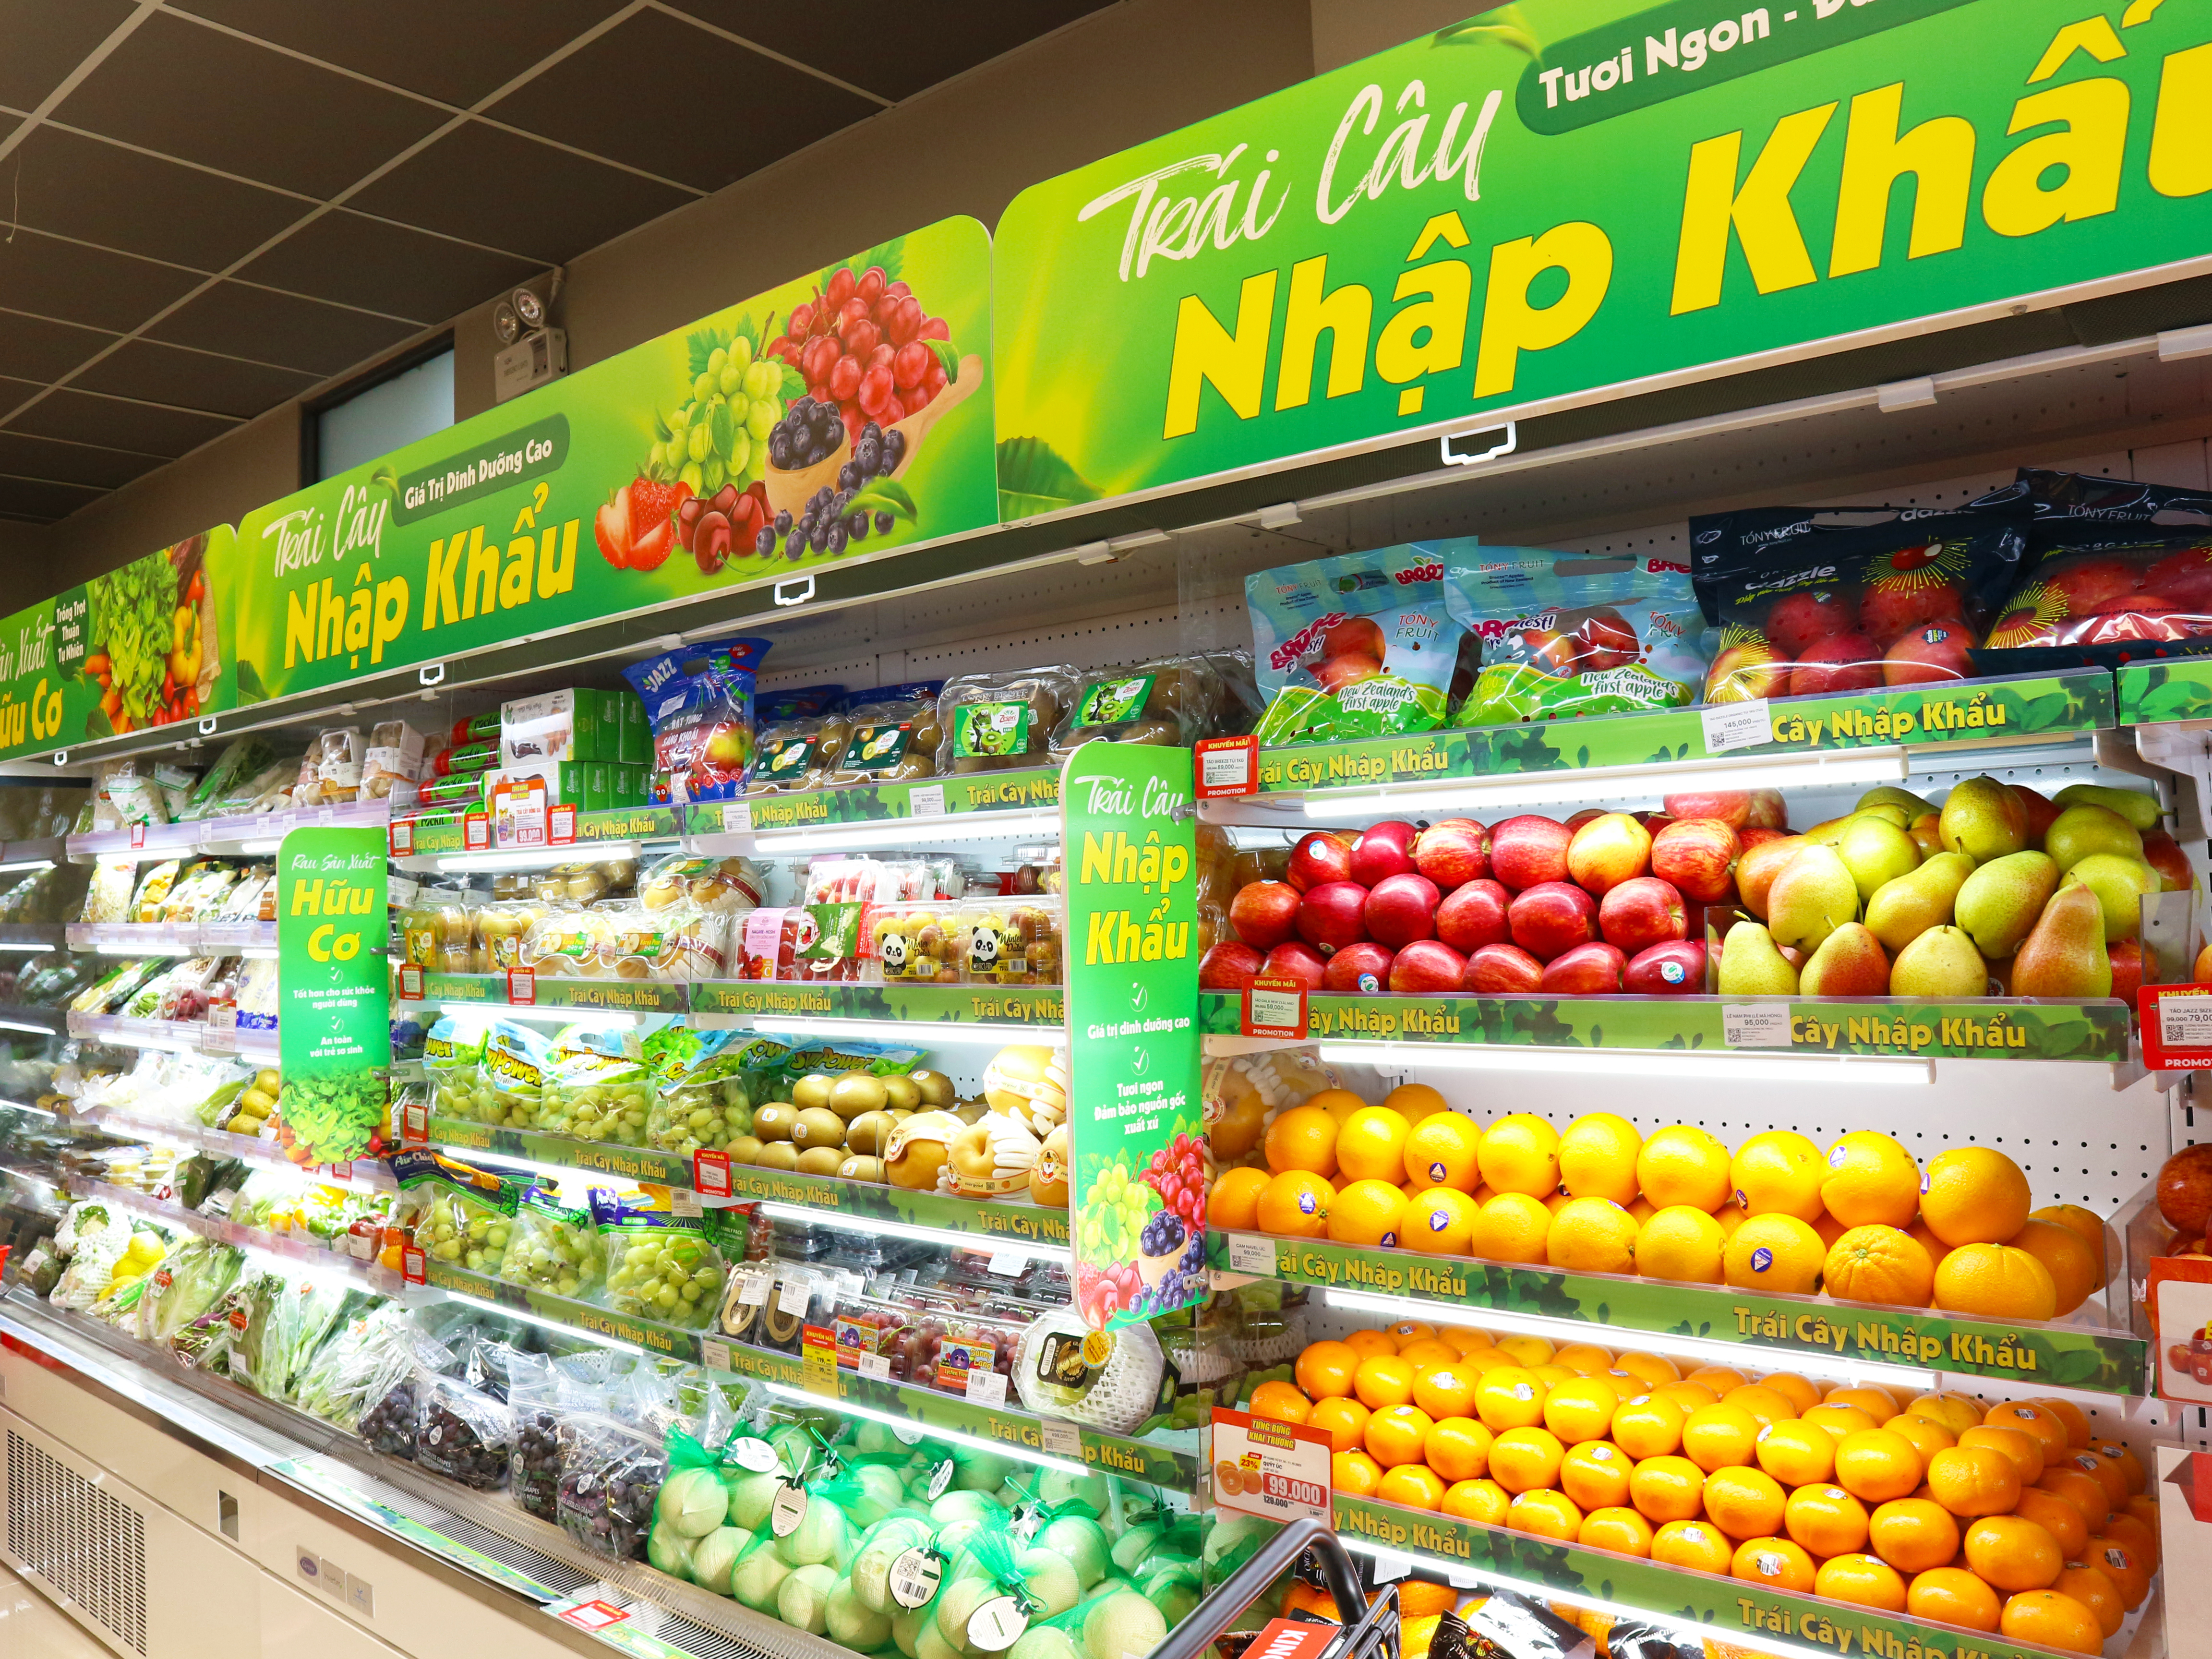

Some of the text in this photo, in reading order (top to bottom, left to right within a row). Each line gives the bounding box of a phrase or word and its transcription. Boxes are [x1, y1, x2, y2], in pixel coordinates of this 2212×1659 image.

[1538, 5, 1772, 109] Tươi Ngon
[1078, 80, 1504, 282] Trái Cây
[1162, 208, 1614, 440] Nhập
[405, 439, 553, 510] Giá Trị Dinh Dưỡng Cao
[2068, 503, 2151, 521] TÓNY FRUIT
[262, 484, 387, 577] Trái Cây
[1479, 559, 1544, 573] TÓNY FRUIT
[284, 481, 580, 670] Nhập Khẩu
[1275, 579, 1322, 594] TÓNY FRUIT
[57, 599, 86, 624] Trồng Trọt
[1399, 611, 1439, 628] TÓNY
[62, 622, 80, 641] Thuận
[1395, 627, 1440, 642] FRUIT
[15, 614, 56, 681] Xuất
[58, 642, 84, 665] Tự Nhiên
[648, 657, 677, 693] JAZZ
[1123, 685, 1141, 695] Zespri
[1595, 680, 1664, 699] first apple
[1345, 696, 1400, 711] first apple
[0, 678, 63, 749] ữu Cơ
[999, 712, 1017, 723] Zespri
[1771, 714, 1824, 746] Cây
[1831, 706, 1914, 742] Nhập
[1922, 691, 2006, 732] Khẩu
[1724, 718, 1752, 728] 145,000
[1208, 740, 1234, 749] KHUYẾN
[1207, 787, 1246, 796] PROMOTION
[1074, 774, 1184, 826] Trái Cây
[291, 852, 381, 871] Rau Sản Xuất
[1080, 830, 1190, 895] Nhập
[289, 878, 374, 916] Hữu
[1085, 897, 1190, 966] Khẩu
[307, 923, 361, 962] Cơ
[907, 938, 928, 951] Winter
[998, 933, 1023, 947] Winter
[1006, 941, 1025, 953] Dates
[914, 946, 930, 957] Dates
[884, 967, 902, 976] GOLD
[972, 962, 992, 971] GOLD
[1254, 979, 1281, 987] KHUYẾN
[293, 984, 375, 998] Tốt hơn cho sức khỏe
[2158, 987, 2209, 998] KHUYẾN
[312, 996, 358, 1010] người dùng
[1744, 1019, 1769, 1027] 95,000
[2188, 1014, 2212, 1023] 79,00
[1087, 1016, 1190, 1040] Giá trị dinh dưỡng cao
[1253, 1028, 1294, 1037] PROMOTION
[1790, 1011, 2026, 1053] Cây Nhập Khẩu
[321, 1034, 352, 1046] An toàn
[310, 1044, 363, 1058] với trẻ sơ sinh
[2164, 1058, 2212, 1067] PROMO
[1117, 1079, 1164, 1098] Tươi ngon
[1094, 1090, 1186, 1122] Đảm bảo nguồn gốc
[1124, 1117, 1158, 1136] xuất xứ
[395, 1153, 412, 1167] Air
[703, 1188, 725, 1196] PROMOTION
[720, 1226, 733, 1234] FAMILY
[579, 1311, 672, 1352] Trái Cây Nhập Khẩu
[806, 1331, 825, 1340] KHUYẾN
[860, 1327, 878, 1340] Sunny
[1733, 1306, 2037, 1371] Trái Cây Nhập Khẩu
[863, 1336, 877, 1348] Land
[970, 1347, 993, 1361] Sunny
[974, 1358, 993, 1370] Land
[1251, 1419, 1291, 1436] TƯNG BỪNG
[1248, 1431, 1295, 1449] KHAI TRƯƠNG
[1240, 1459, 1258, 1469] 23%
[1269, 1476, 1321, 1504] 99.000
[1348, 1508, 1471, 1559] Nhập Khẩu
